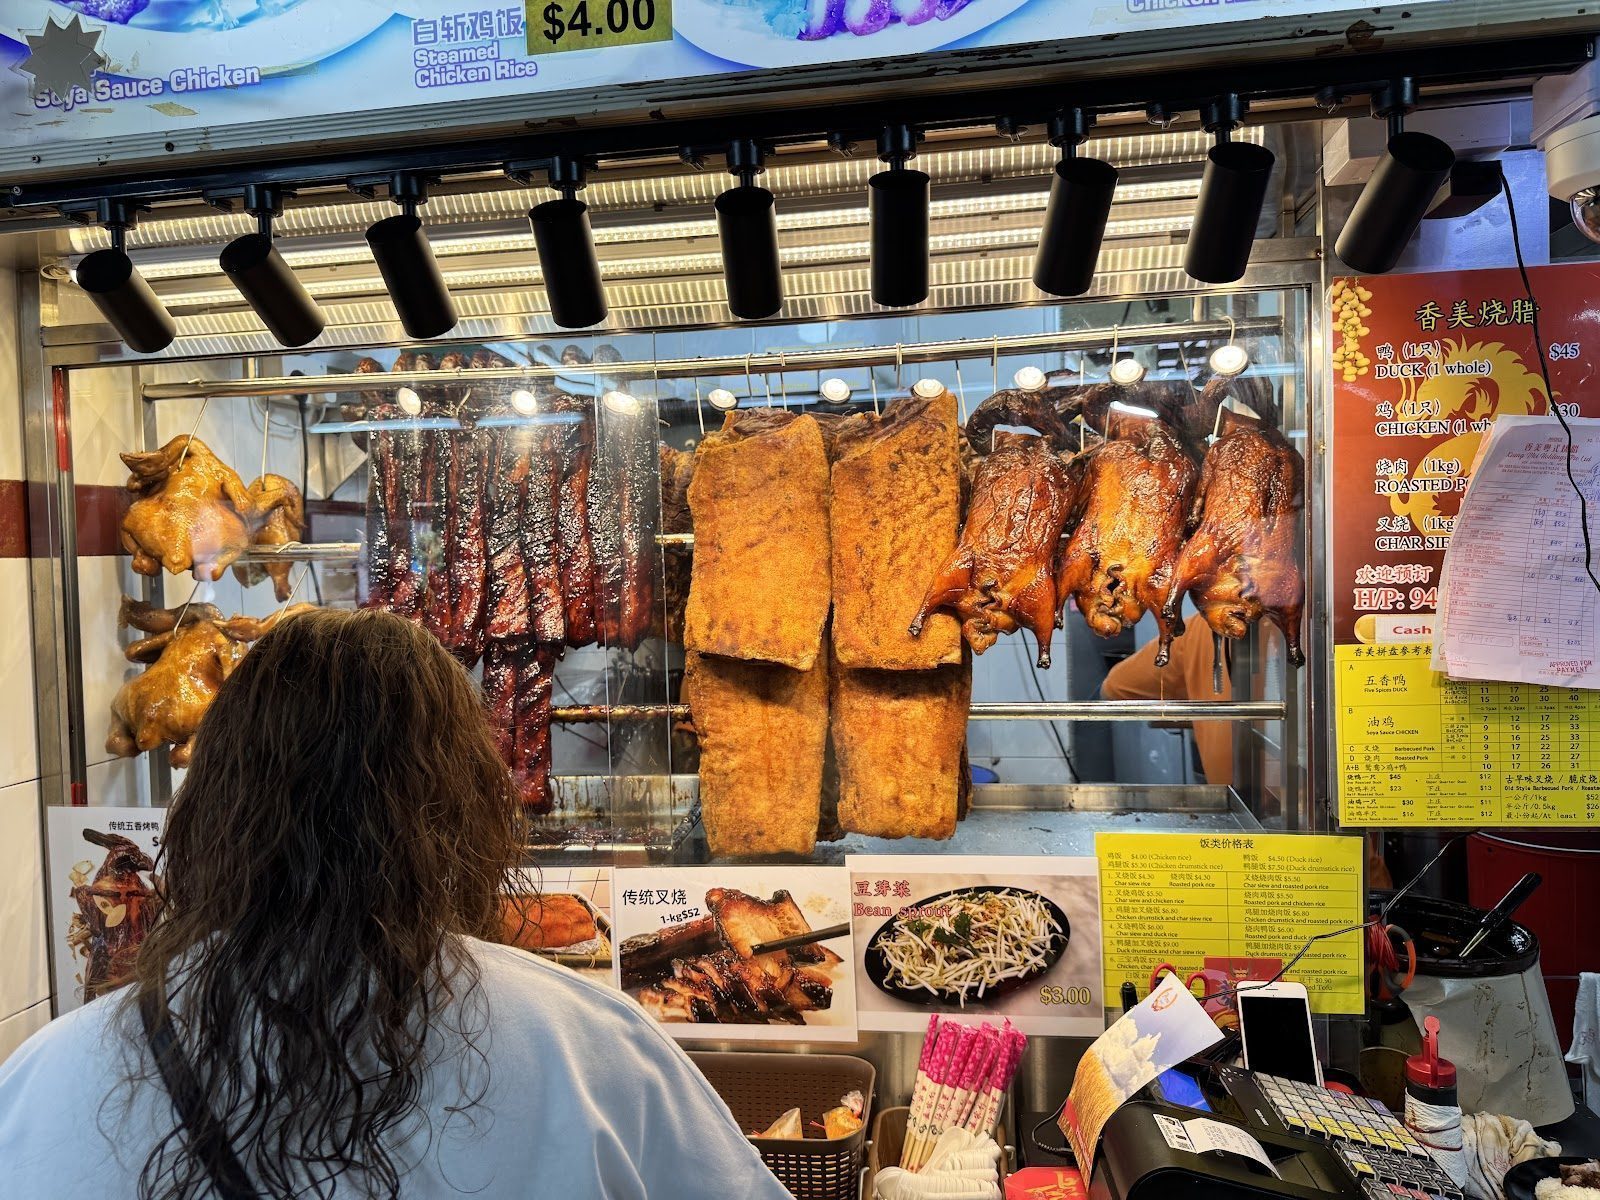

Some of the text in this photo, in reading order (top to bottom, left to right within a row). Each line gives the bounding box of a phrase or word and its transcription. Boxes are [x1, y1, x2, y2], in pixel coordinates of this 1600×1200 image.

[543, 0, 655, 44] $4.00
[413, 40, 499, 68] Steamed
[94, 76, 164, 101] Sauce
[168, 63, 261, 93] Chicken
[415, 59, 538, 88] Chicken Rice
[1415, 299, 1540, 331] 香美烧腊
[1376, 343, 1393, 360] 鸭
[1550, 343, 1580, 360] $45
[1375, 360, 1491, 378] DUCK (1 whole)
[1376, 402, 1393, 418] 鸡
[1375, 421, 1451, 436] CHICKEN
[1453, 420, 1466, 436] (1
[1376, 458, 1460, 475] 烧肉 (1kg)
[1375, 479, 1453, 494] ROASTED
[1376, 516, 1456, 533] 叉烧 (1kg
[1375, 537, 1423, 551] CHAR
[1355, 564, 1434, 584] 欢迎预订
[1353, 587, 1404, 610] H/P:
[1392, 625, 1432, 635] Cash
[1364, 673, 1406, 686] 五香鸭
[1367, 715, 1395, 728] 油鸡
[108, 821, 160, 831] 传统五香烤鸭
[1199, 838, 1254, 849] 饭类价格表
[622, 888, 687, 906] 传统叉烧
[853, 879, 912, 898] 豆芽菜
[853, 902, 951, 919] Bean sprout
[1039, 985, 1091, 1005] $3.00
